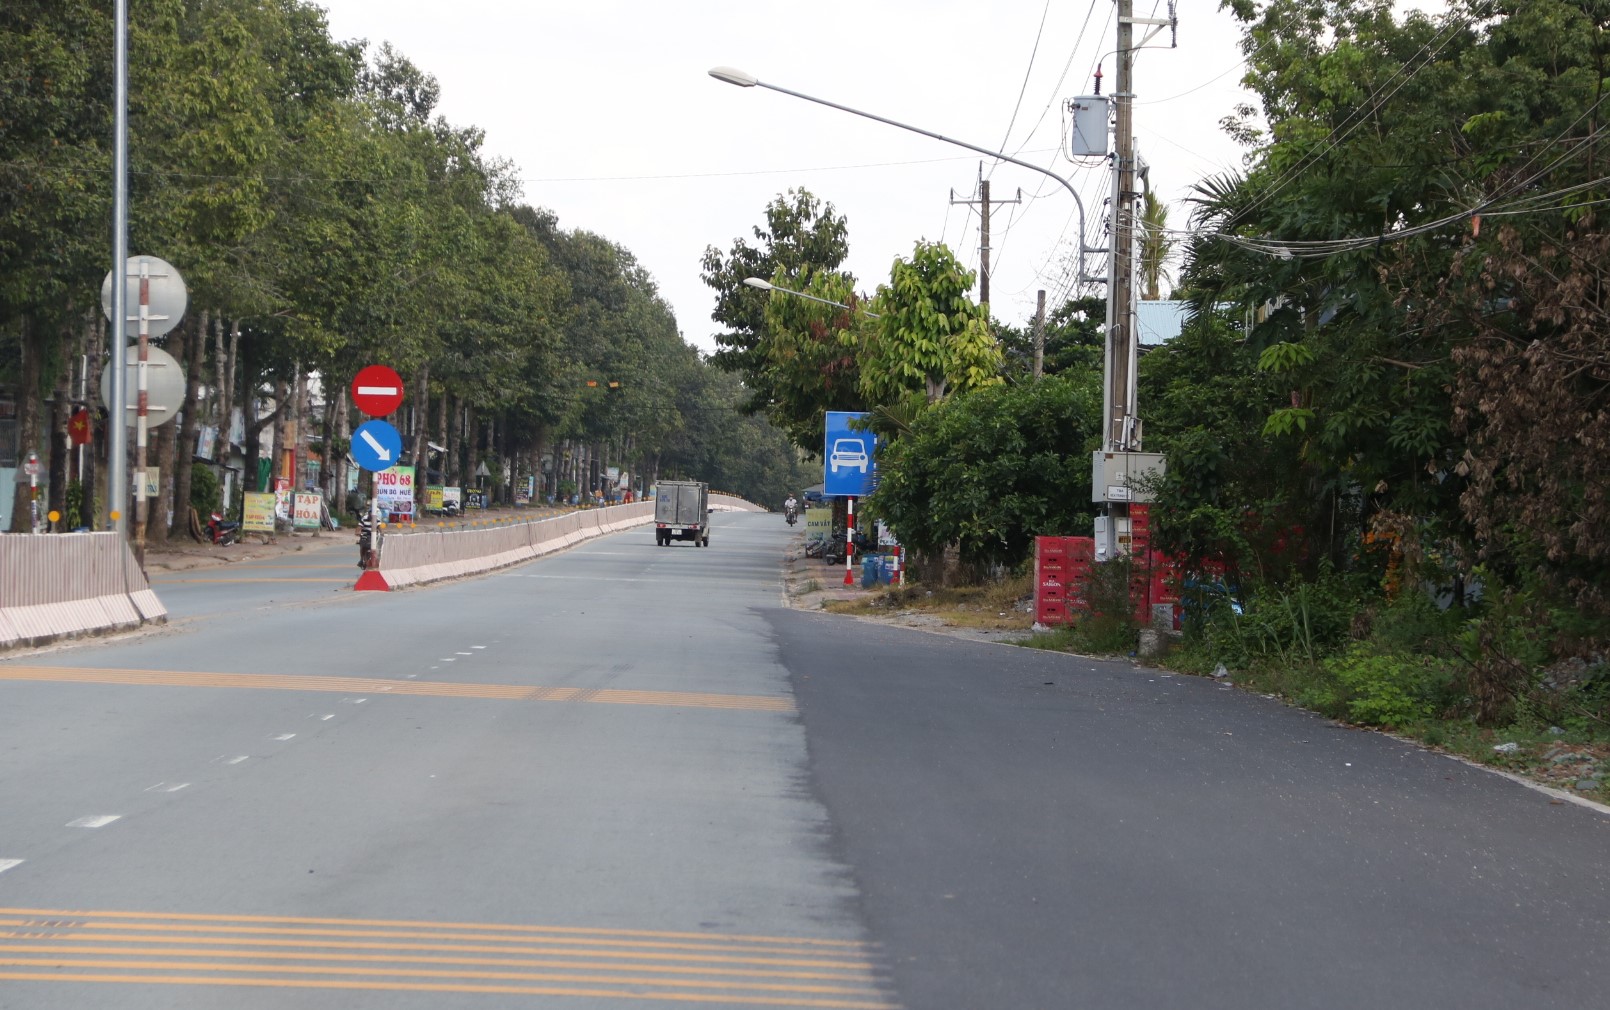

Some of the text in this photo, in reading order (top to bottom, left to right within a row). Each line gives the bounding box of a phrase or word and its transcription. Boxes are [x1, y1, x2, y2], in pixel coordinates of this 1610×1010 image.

[377, 468, 410, 485] PHỞ 68
[297, 495, 318, 505] TẠP
[296, 508, 318, 519] HÓA
